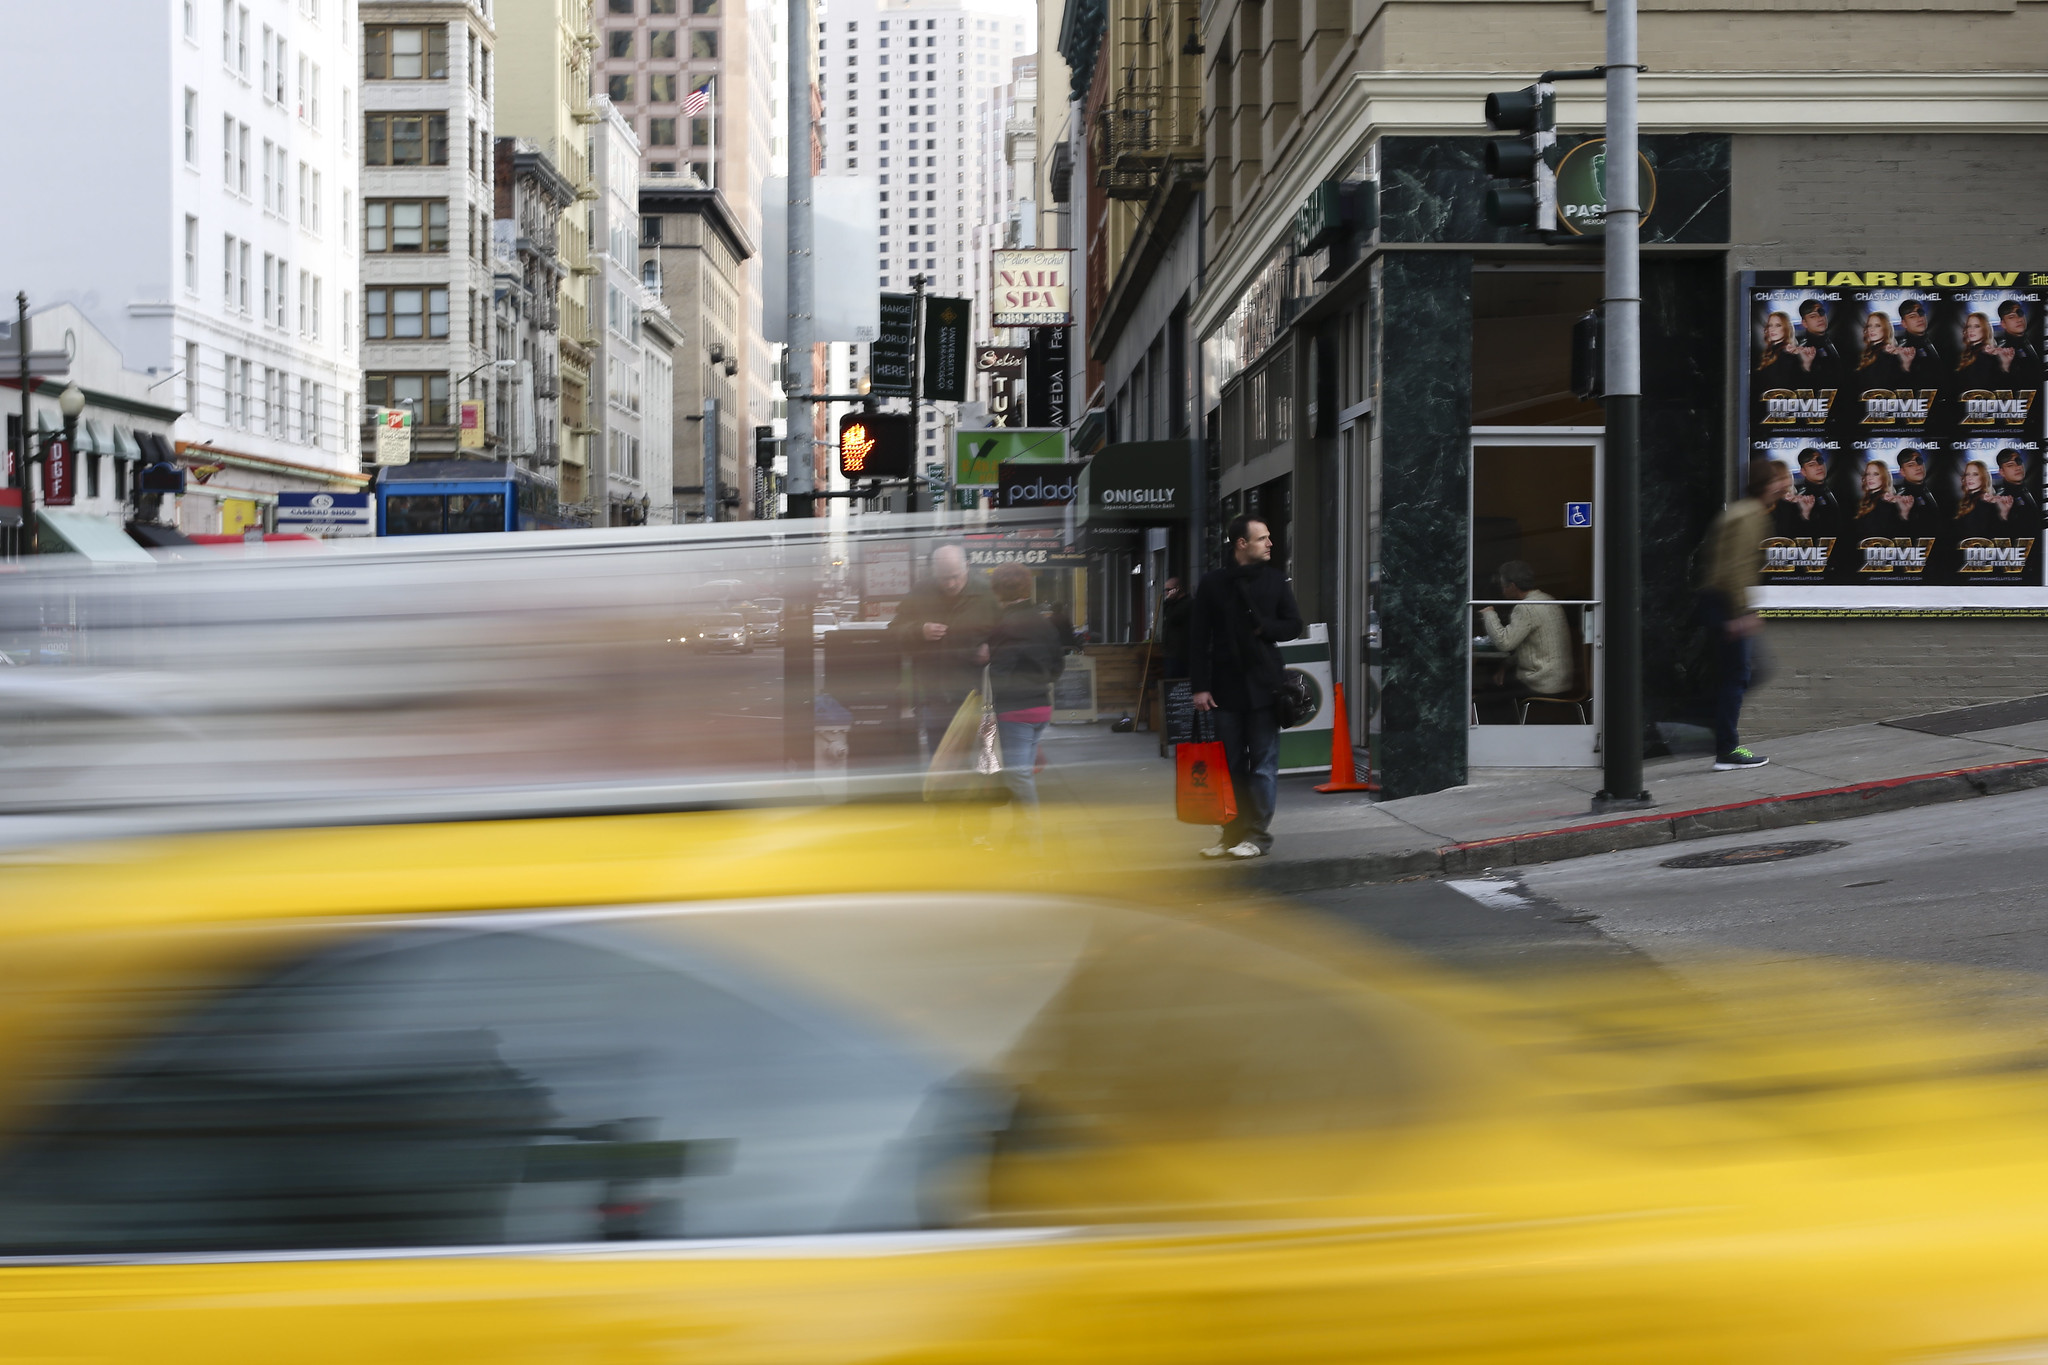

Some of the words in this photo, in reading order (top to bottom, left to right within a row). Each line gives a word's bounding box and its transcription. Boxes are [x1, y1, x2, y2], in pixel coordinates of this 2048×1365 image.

[1034, 252, 1066, 265] Orchid
[995, 270, 1064, 287] NAIL
[1794, 272, 2020, 286] HARROW
[1005, 291, 1056, 308] SPA
[1756, 292, 1799, 300] CHASTAIN
[1808, 292, 1842, 300] KIMMEL
[1856, 292, 1899, 300] CHASTAIN
[1909, 292, 1942, 300] KIMMEL
[1954, 293, 1998, 301] CHASTAIN
[2008, 293, 2041, 301] KIMMEL
[881, 304, 910, 314] HANGE
[997, 313, 1065, 324] 989-9633
[948, 327, 956, 377] UNIVERSITY
[978, 350, 1022, 369] Selix
[878, 364, 906, 376] HERE
[938, 346, 947, 390] FRANCISCO
[947, 380, 953, 390] OF
[1051, 370, 1064, 427] AVEDA
[1770, 399, 1829, 411] MOVIE
[1868, 399, 1928, 412] MOVIE
[1969, 399, 2028, 412] MOVIE
[1755, 441, 1798, 449] CHASTAIN
[1807, 441, 1841, 449] KIMMEL
[1853, 441, 1896, 449] CHASTAIN
[1906, 441, 1940, 449] KIMMEL
[1103, 488, 1175, 503] ONIGILLY
[970, 550, 1048, 564] MASSAGE
[1768, 547, 1828, 560] MOVIE
[1867, 547, 1926, 560] MOVIE
[1967, 547, 2026, 560] MOVIE
